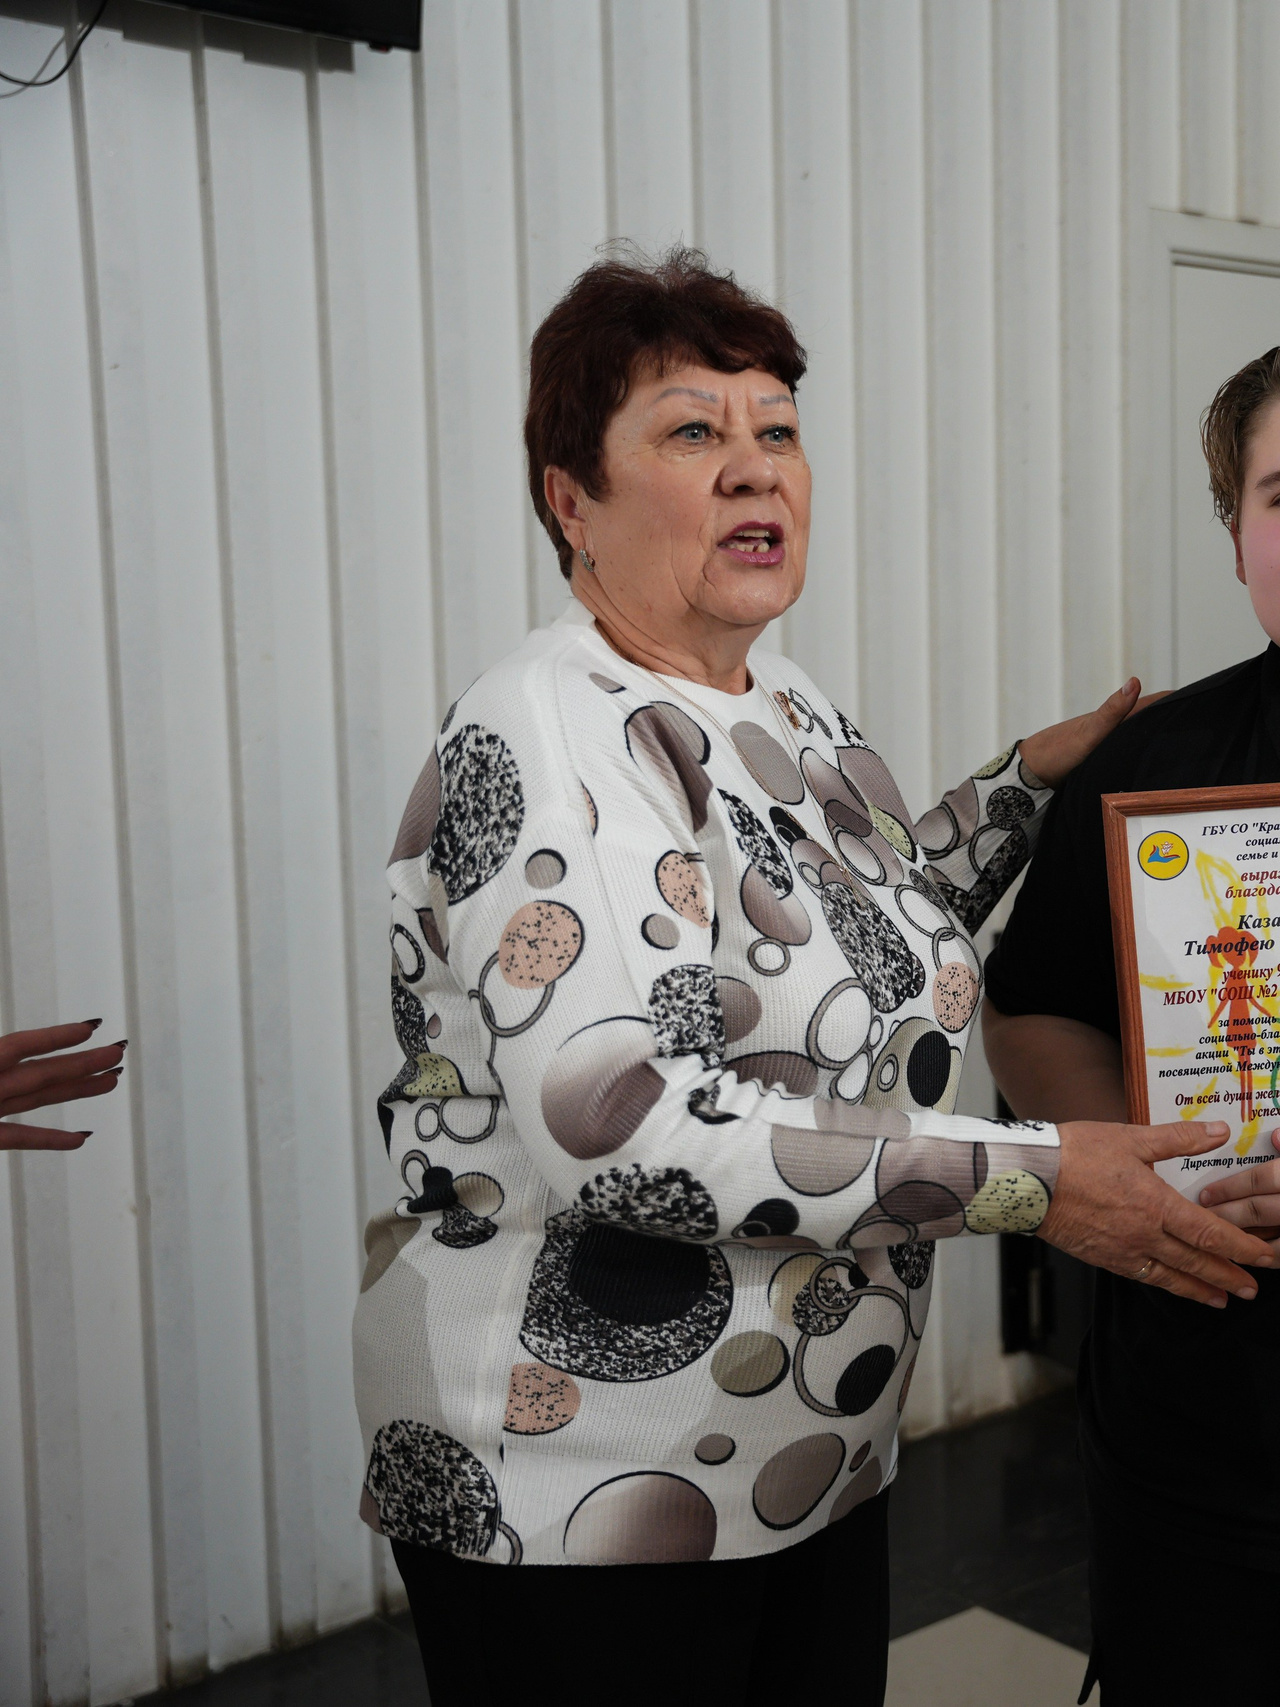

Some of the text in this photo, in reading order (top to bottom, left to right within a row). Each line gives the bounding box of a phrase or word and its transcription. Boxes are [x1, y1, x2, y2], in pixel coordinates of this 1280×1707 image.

[1202, 825, 1228, 836] ГБУ
[1230, 823, 1248, 834] СО
[1237, 850, 1268, 861] семье
[1271, 850, 1279, 858] и
[1184, 938, 1275, 956] Тимофею
[1223, 966, 1274, 983] ученику
[1164, 990, 1206, 1006] МБОУ
[1257, 984, 1277, 998] №2
[1218, 1019, 1230, 1028] за
[1233, 1015, 1276, 1027] помощь
[1196, 1048, 1230, 1060] акции
[1159, 1062, 1232, 1078] посвященной
[1175, 1094, 1194, 1106] От
[1197, 1092, 1220, 1103] всей
[1223, 1090, 1252, 1104] души
[1181, 1156, 1233, 1171] Директор
